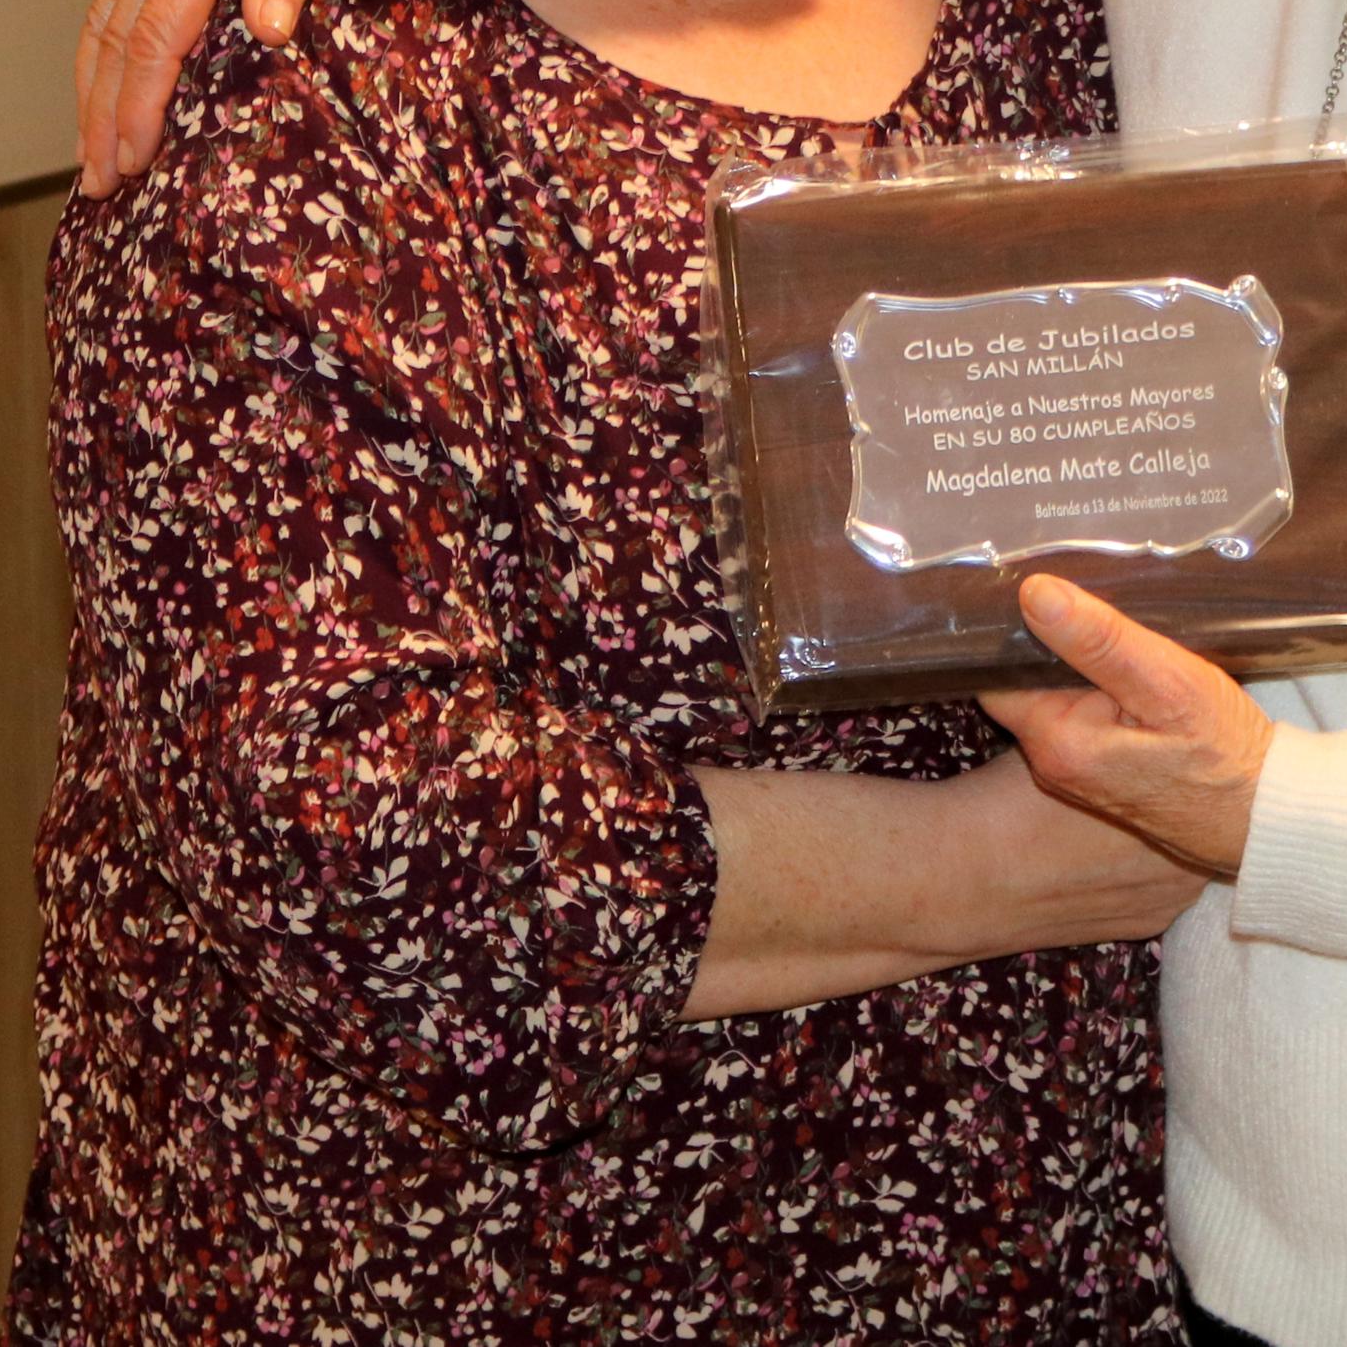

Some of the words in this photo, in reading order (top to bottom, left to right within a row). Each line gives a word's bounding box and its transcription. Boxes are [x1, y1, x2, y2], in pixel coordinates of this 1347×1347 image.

[904, 337, 974, 361] Club
[987, 334, 1027, 354] de
[1039, 319, 1196, 350] Jubilados
[967, 360, 1019, 381] SAN
[1026, 348, 1124, 376] MILLÁN
[904, 400, 1005, 426] Homenaje
[1011, 405, 1023, 415] a
[1029, 392, 1122, 415] Nuestros
[1130, 383, 1215, 411] Mayores
[933, 434, 966, 451] EN
[973, 430, 1003, 447] SU
[1010, 427, 1037, 443] 80
[1043, 411, 1196, 442] CUMPLEAÑOS
[926, 461, 1052, 496] Magdalena
[1060, 457, 1122, 482] Mate
[1129, 448, 1211, 478] Calleja
[1035, 501, 1080, 518] Baltanás
[1083, 506, 1091, 515] a
[1092, 499, 1105, 514] 13
[1107, 497, 1122, 513] de
[1123, 493, 1183, 511] Noviembre
[1184, 492, 1198, 506] de
[1200, 488, 1229, 504] 2022
